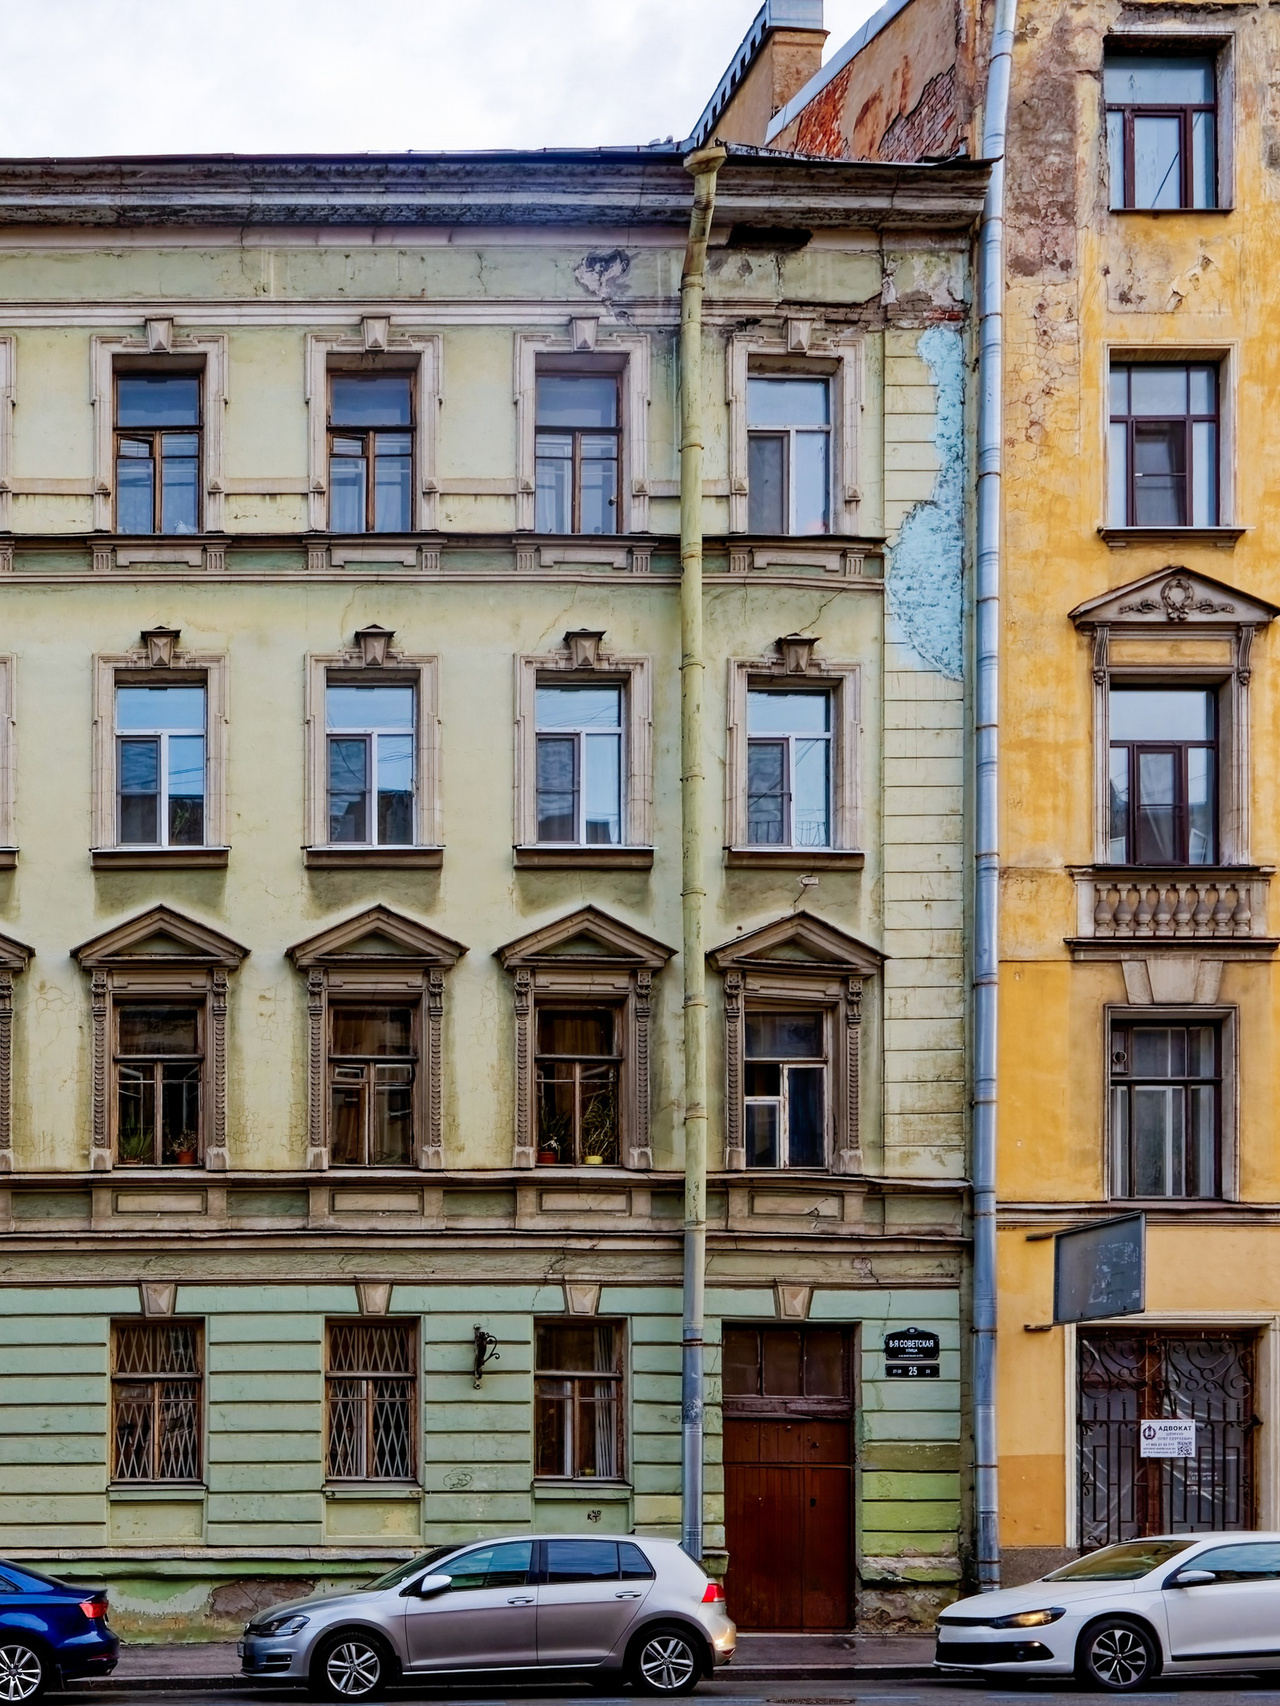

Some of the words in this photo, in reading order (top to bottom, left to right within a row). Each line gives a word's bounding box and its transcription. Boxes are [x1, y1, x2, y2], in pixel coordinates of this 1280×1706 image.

[889, 1340, 899, 1348] 8-Я
[900, 1340, 934, 1348] СОВЕТСКАЯ
[908, 1366, 918, 1376] 25
